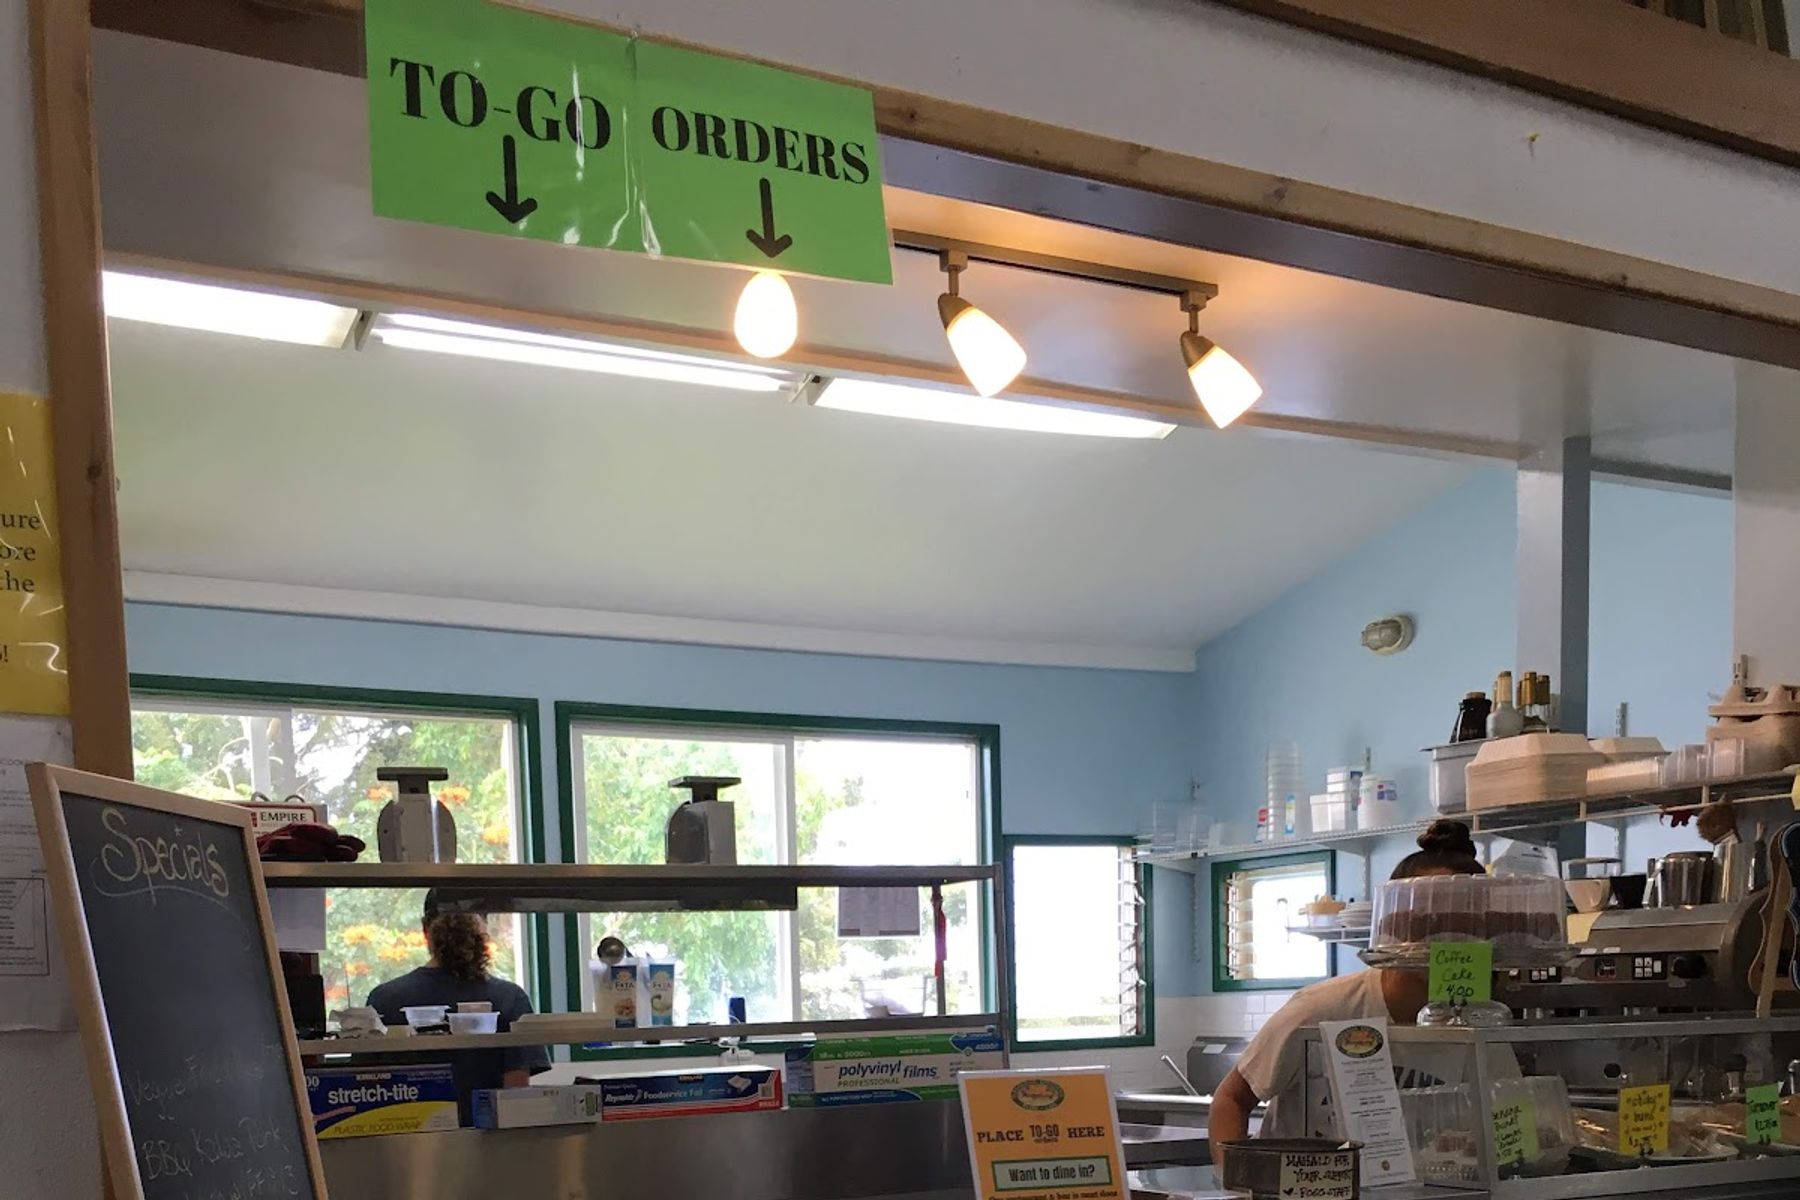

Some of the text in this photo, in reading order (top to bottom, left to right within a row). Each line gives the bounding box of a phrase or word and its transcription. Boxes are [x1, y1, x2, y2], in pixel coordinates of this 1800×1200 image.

[390, 57, 870, 185] TO-GO ORDERS
[0, 569, 35, 592] he
[259, 811, 307, 822] EMPIRE
[100, 805, 229, 907] Specials
[1435, 949, 1473, 965] Coffee
[355, 1073, 392, 1081] KIRKLAND
[838, 1060, 901, 1079] polyvinyl
[902, 1063, 938, 1078] films
[836, 1078, 900, 1088] PROFESSIONAL
[327, 1083, 419, 1105] stretch-tite
[976, 1123, 1106, 1144] PLACE TO-GO HERE
[1008, 1163, 1095, 1182] Want to dine in?
